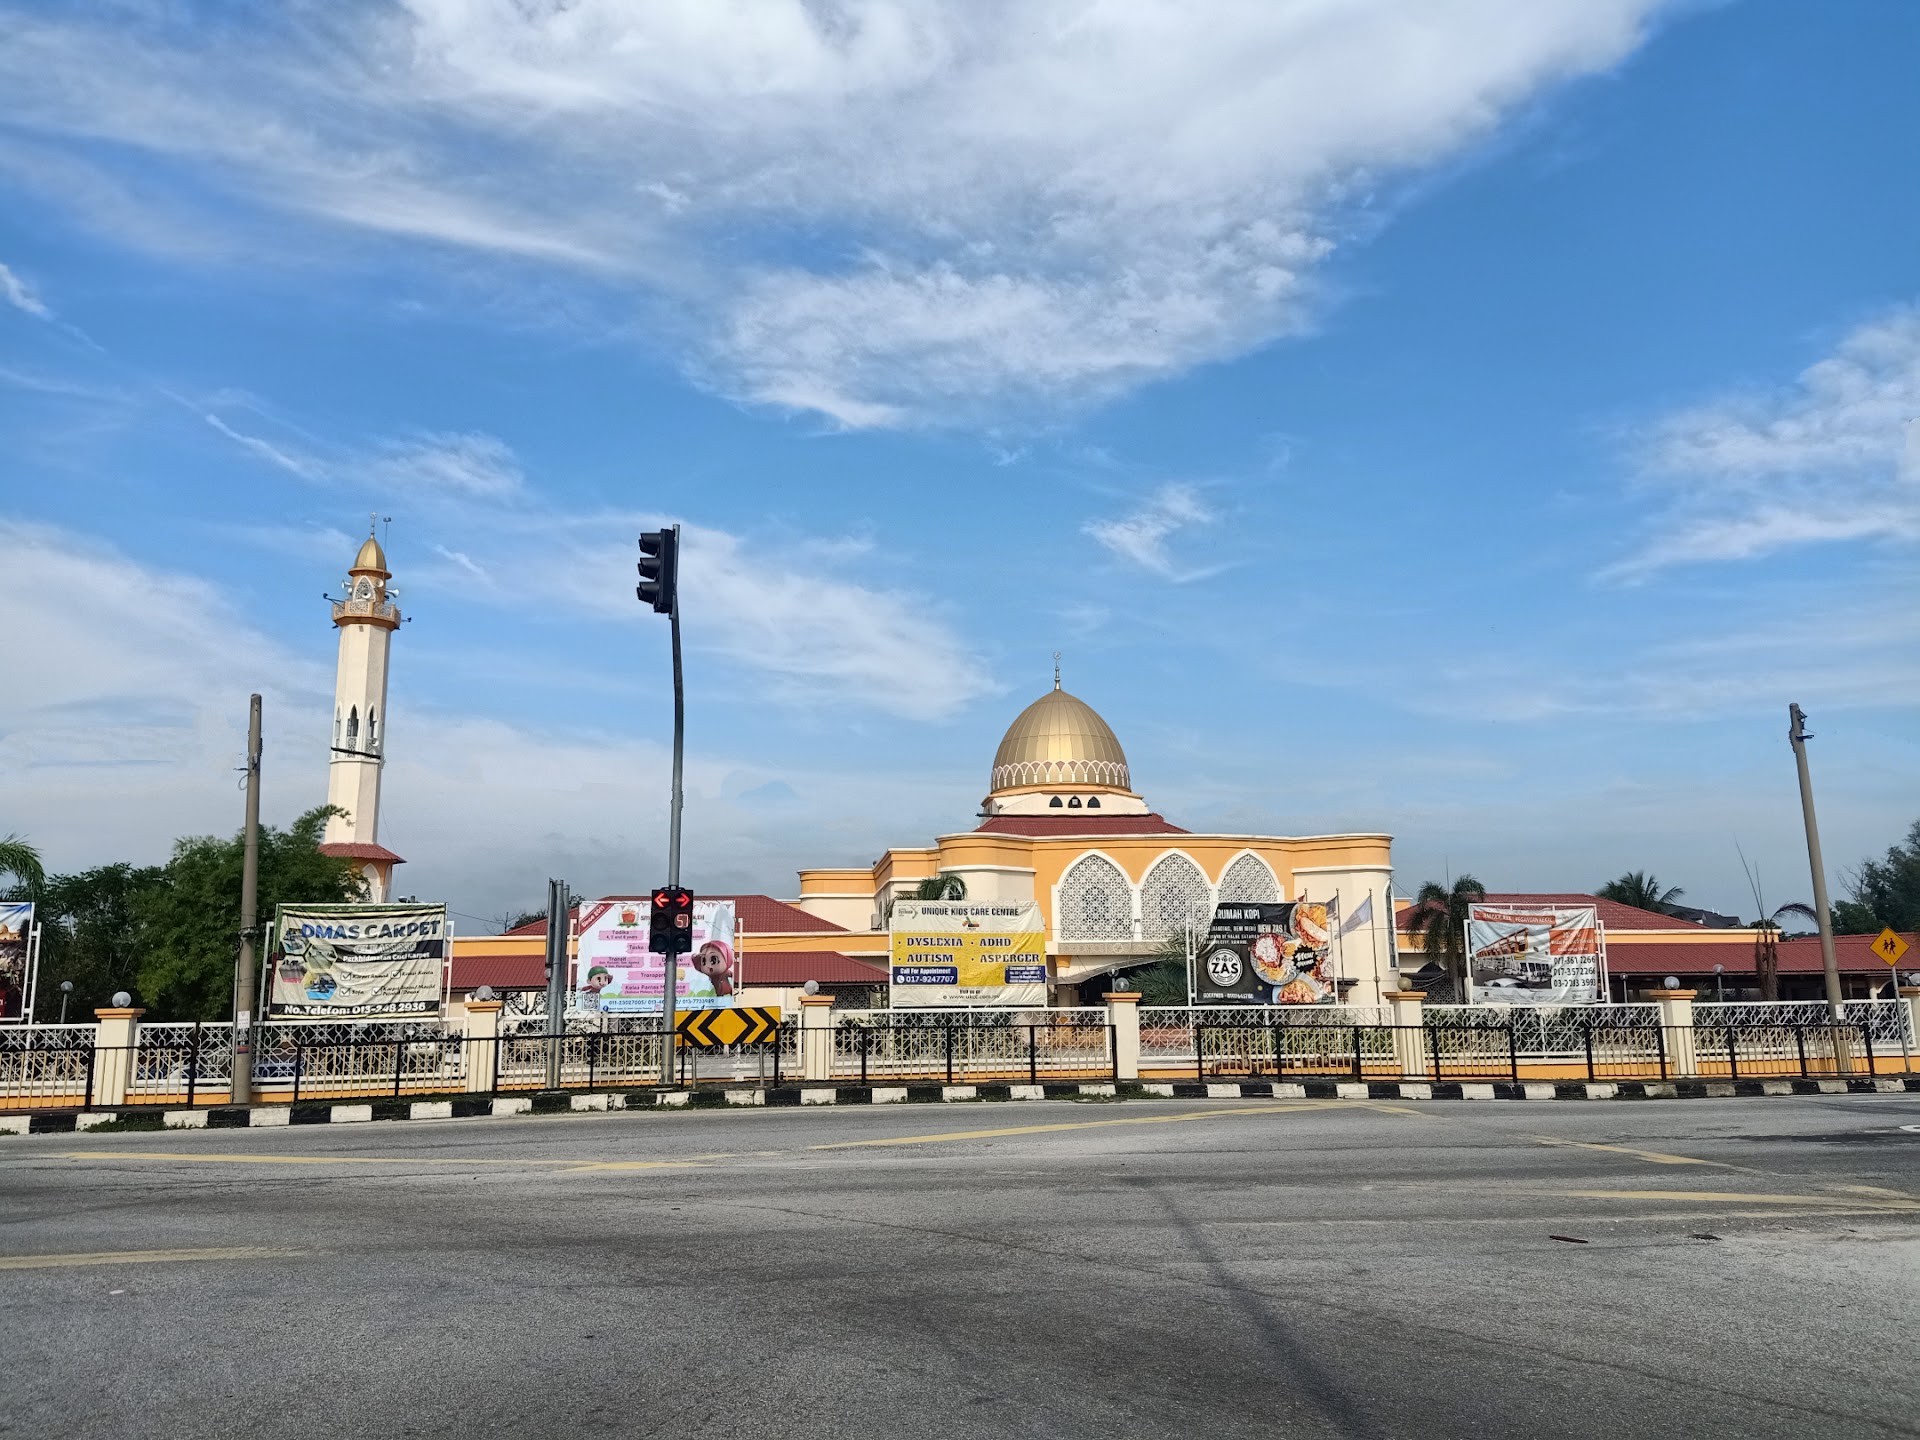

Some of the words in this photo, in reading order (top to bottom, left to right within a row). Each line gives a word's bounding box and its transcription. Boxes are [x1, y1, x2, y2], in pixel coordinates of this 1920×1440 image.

[921, 907, 949, 916] UNIQUE
[951, 907, 968, 916] KIDS
[970, 908, 989, 916] CARE
[991, 908, 1019, 917] CENTRE
[1217, 909, 1242, 920] RUMAH
[1244, 909, 1261, 919] KOPI
[301, 923, 360, 940] DMAS
[364, 920, 441, 939] CARPET
[907, 937, 963, 947] DYSLEXIA
[979, 938, 1011, 947] ADHD
[343, 954, 392, 962] Perkhidmatan
[907, 953, 954, 964] AUTISM
[980, 953, 1040, 963] ASPERGER
[1211, 962, 1238, 974] ZAS
[906, 975, 954, 984] 017-9247707
[304, 1005, 350, 1015] Telefon:
[398, 1002, 426, 1012] 2936
